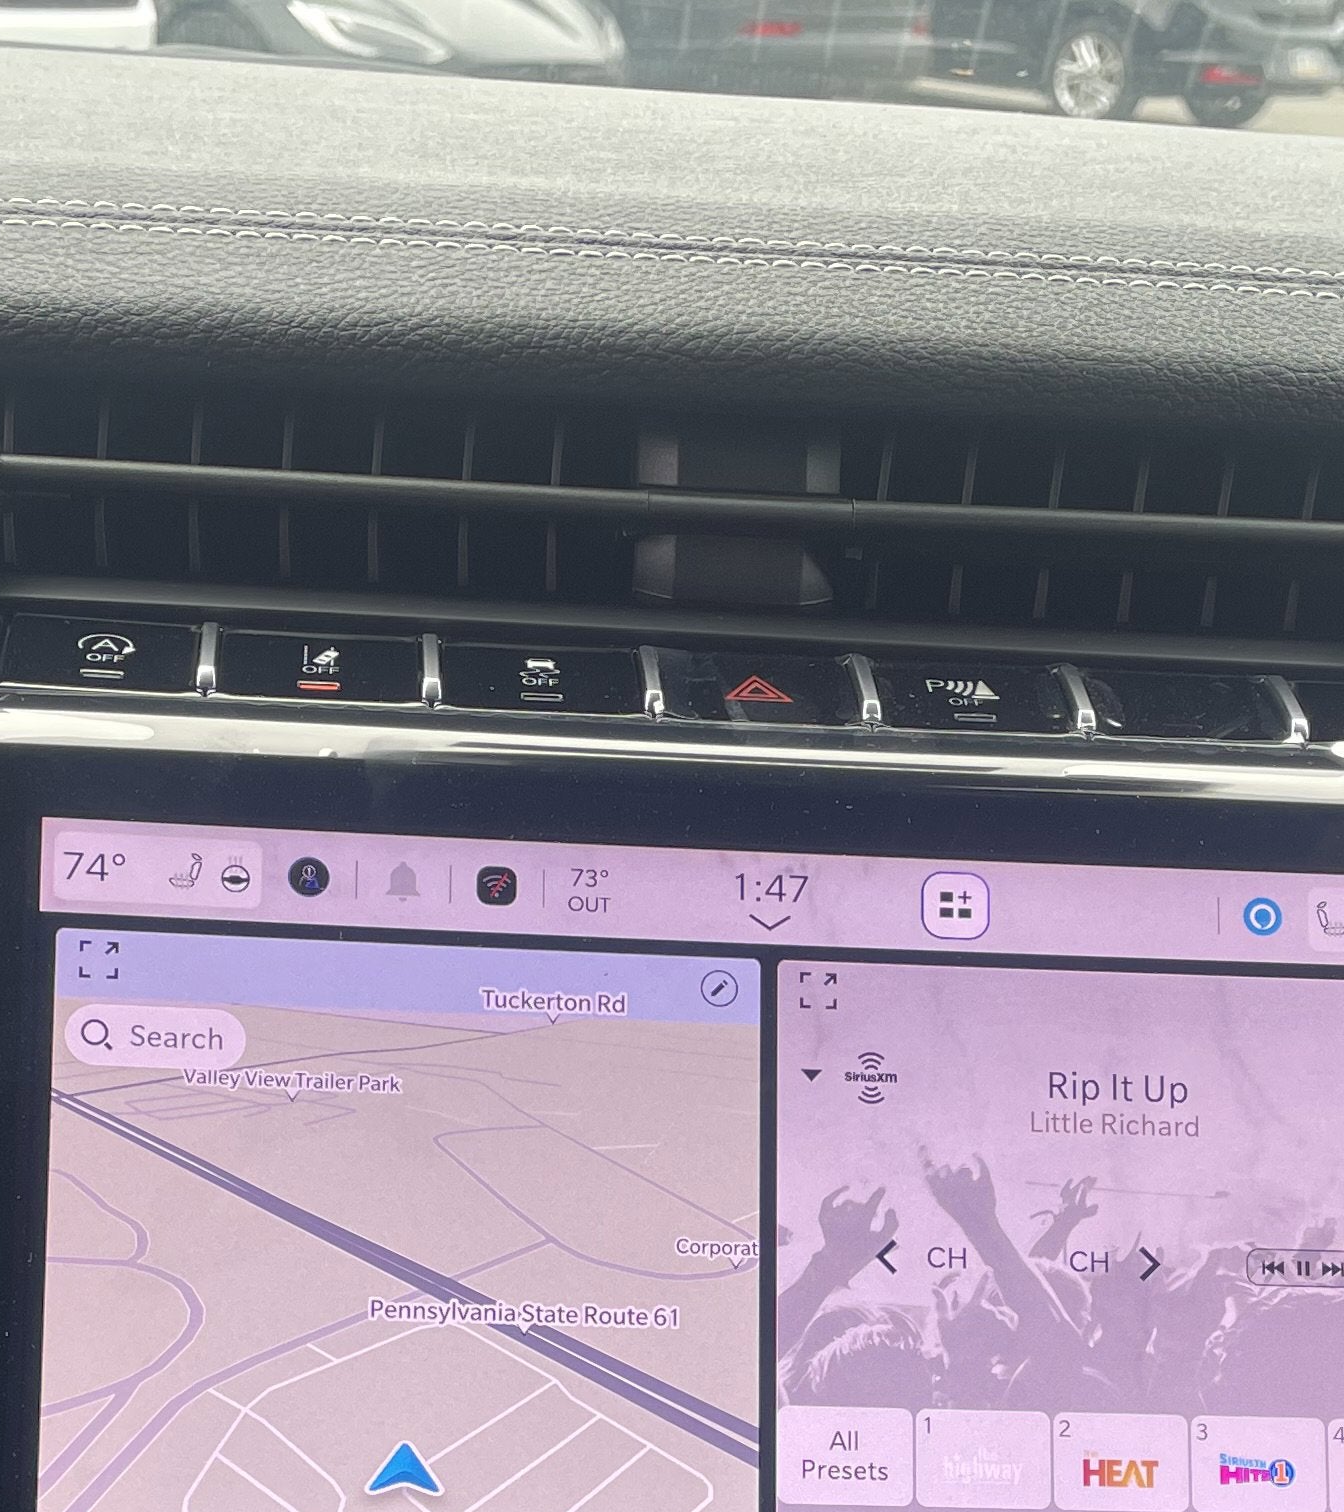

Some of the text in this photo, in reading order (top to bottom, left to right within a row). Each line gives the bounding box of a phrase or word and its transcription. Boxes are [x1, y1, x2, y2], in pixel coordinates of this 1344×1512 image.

[85, 652, 126, 663] OFF
[301, 664, 341, 675] OFF
[62, 850, 127, 883] 74°
[570, 867, 610, 889] 73°
[734, 871, 810, 904] 1:47
[566, 894, 612, 914] OUT
[481, 988, 627, 1014] Tuckerton Rd
[129, 1023, 224, 1052] Search
[184, 1068, 402, 1093] Valley View Trailer Park
[1047, 1071, 1189, 1110] Rip It Up
[1029, 1110, 1200, 1138] Little Richard
[675, 1237, 758, 1259] Corporat
[926, 1246, 968, 1270] CH
[1068, 1250, 1110, 1275] CH
[369, 1300, 679, 1327] Pennsylvania State Route 61
[923, 1415, 932, 1435] 1
[1058, 1419, 1072, 1438] 2
[1196, 1423, 1209, 1441] 3
[828, 1429, 860, 1452] All
[801, 1458, 890, 1482] Presets
[1082, 1458, 1160, 1488] HEAT
